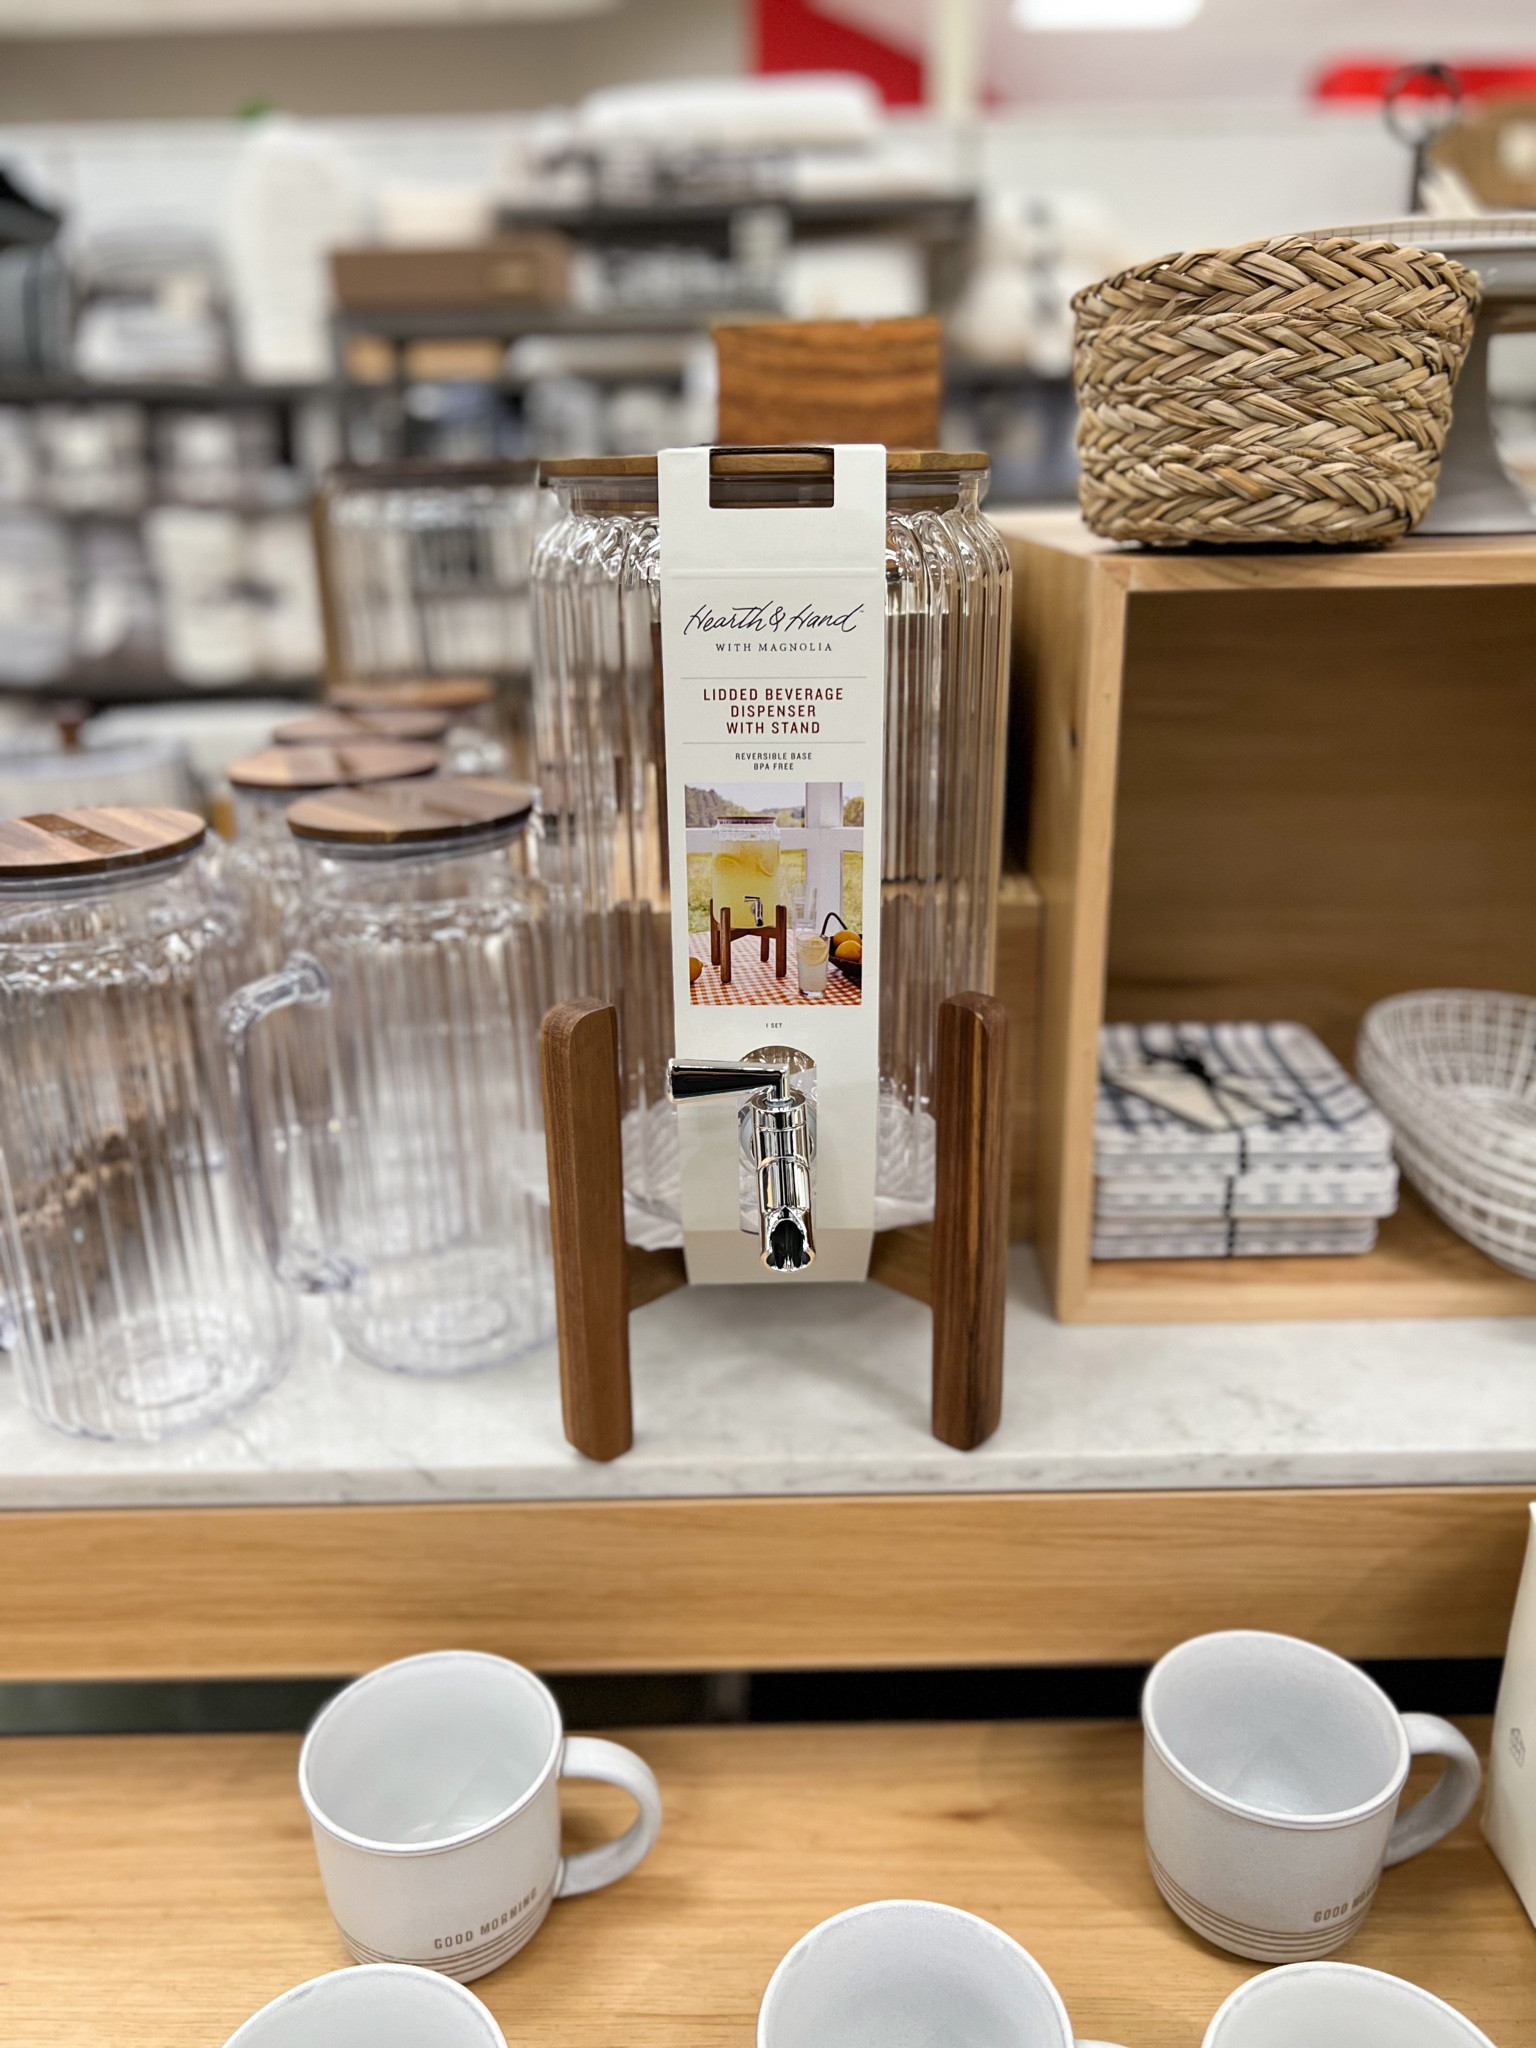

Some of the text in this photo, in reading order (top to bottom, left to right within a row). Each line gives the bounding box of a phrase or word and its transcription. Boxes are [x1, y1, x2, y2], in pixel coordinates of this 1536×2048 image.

[684, 600, 774, 635] Hearth
[769, 606, 786, 632] &
[716, 643, 832, 651] WITH MAGNOLIA
[703, 688, 843, 701] LIDDED BEVERAGE
[731, 705, 816, 717] DISPENSER
[726, 722, 820, 734] WITH STAND
[434, 1887, 537, 1949] GOOD MORNING
[1313, 1902, 1349, 1923] GOOD
